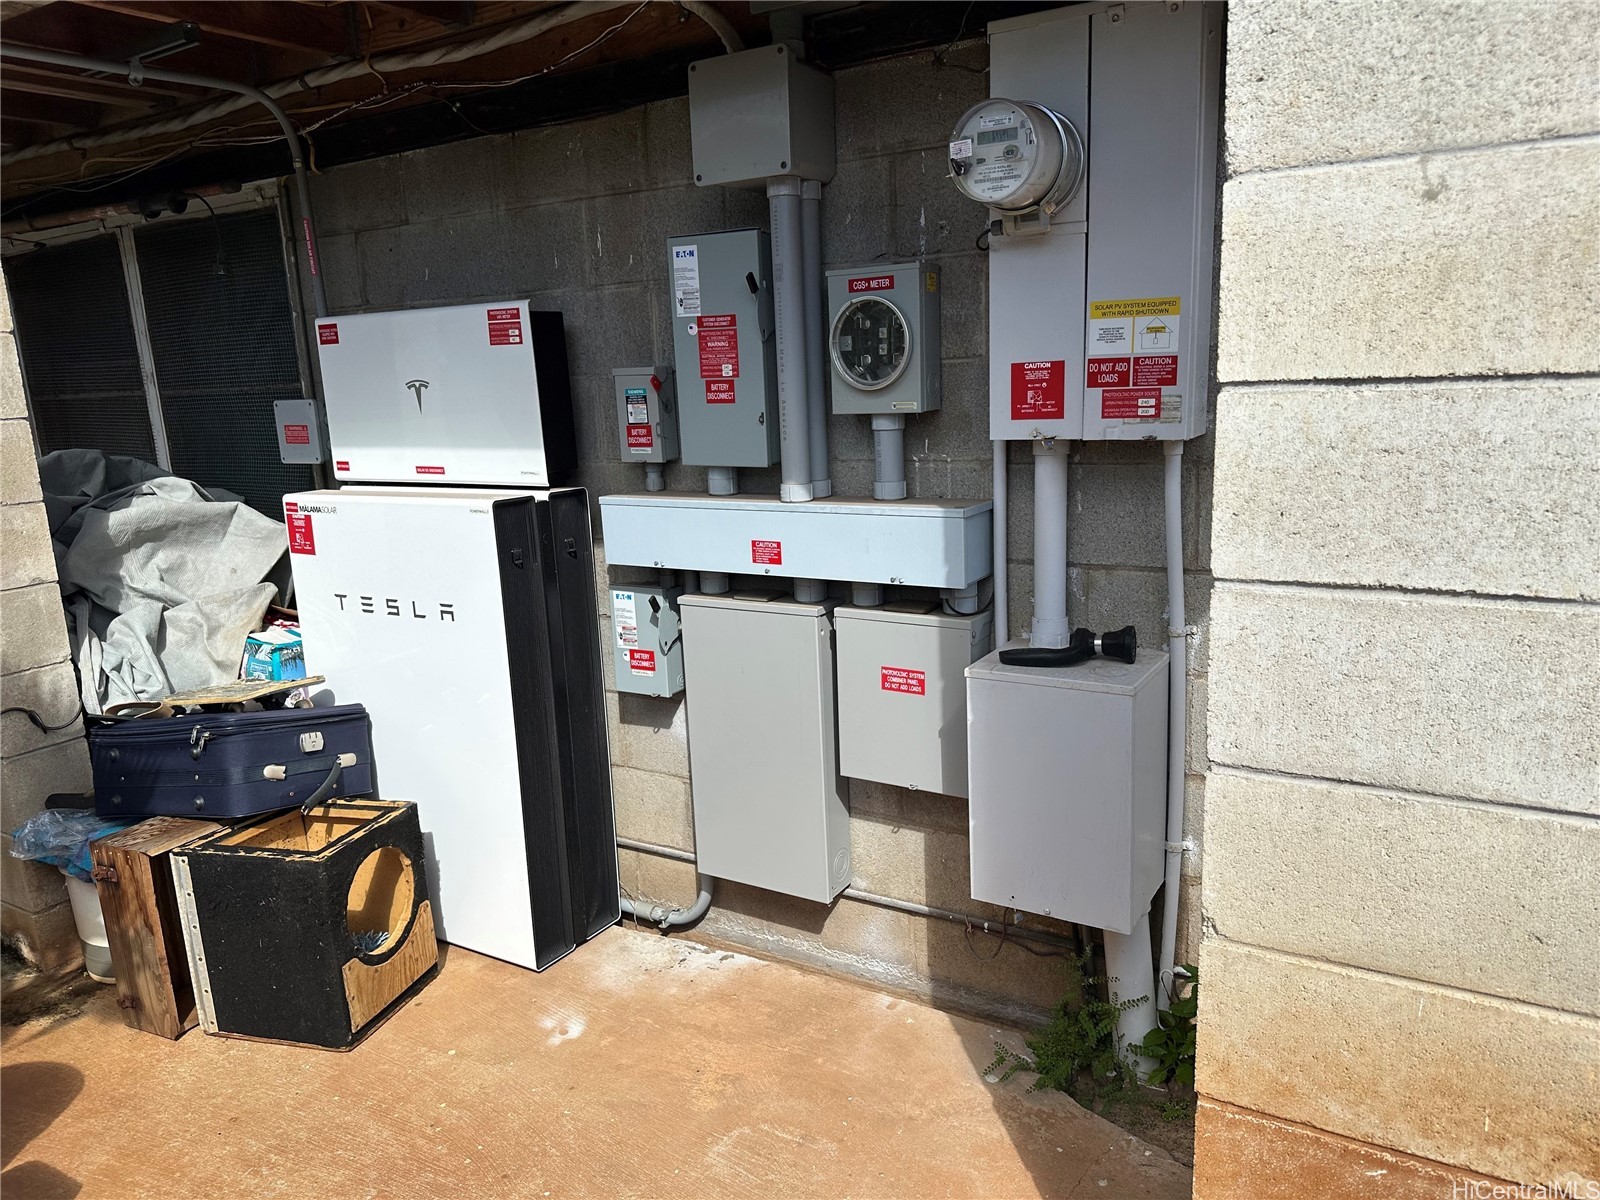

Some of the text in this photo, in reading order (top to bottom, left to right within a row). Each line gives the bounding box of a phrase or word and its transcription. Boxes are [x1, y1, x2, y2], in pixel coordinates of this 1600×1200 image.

[852, 278, 890, 290] CGS+ METER
[1089, 364, 1098, 372] DO
[1100, 363, 1113, 372] NOT
[1115, 363, 1128, 371] ADD
[1098, 374, 1118, 383] LOADS
[334, 594, 455, 621] TESLA
[882, 669, 908, 677] PHOTOVOLTAIC
